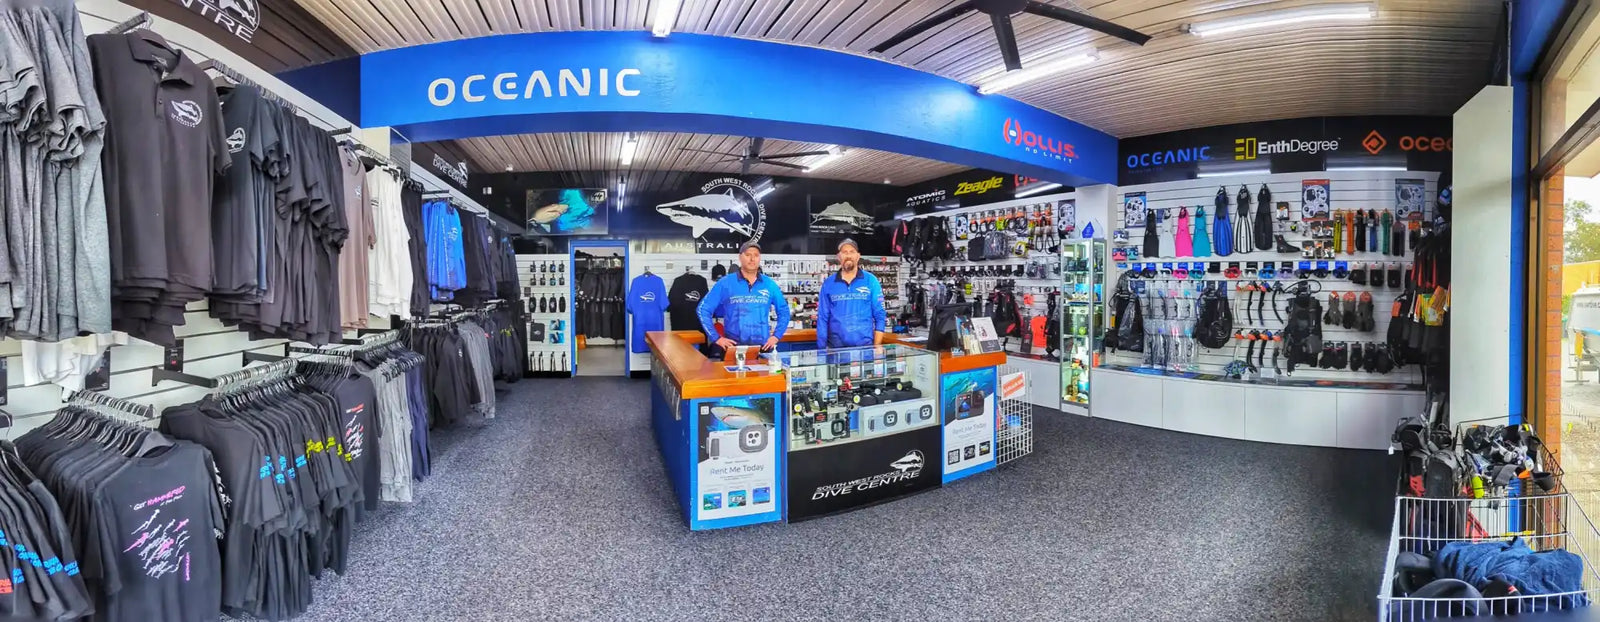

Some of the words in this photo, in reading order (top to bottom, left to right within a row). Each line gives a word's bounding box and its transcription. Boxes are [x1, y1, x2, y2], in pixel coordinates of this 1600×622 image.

[428, 68, 641, 106] OCEANIC
[1258, 139, 1338, 154] EnthDegree
[1127, 146, 1211, 168] OCEANIC
[701, 178, 723, 192] SOUTH
[723, 177, 742, 185] WEST
[954, 176, 1003, 196] Zeagle
[906, 190, 946, 202] ATOMIC
[906, 195, 946, 207] AQUATICS
[759, 203, 767, 219] DIVE
[753, 221, 766, 242] CENTR
[711, 466, 728, 475] Rent
[743, 464, 764, 472] Today
[812, 486, 852, 500] DIVE
[857, 471, 920, 491] CENTRE
[816, 482, 846, 492] SOUTH
[848, 476, 872, 486] WEST
[873, 470, 900, 480] ROCKS
